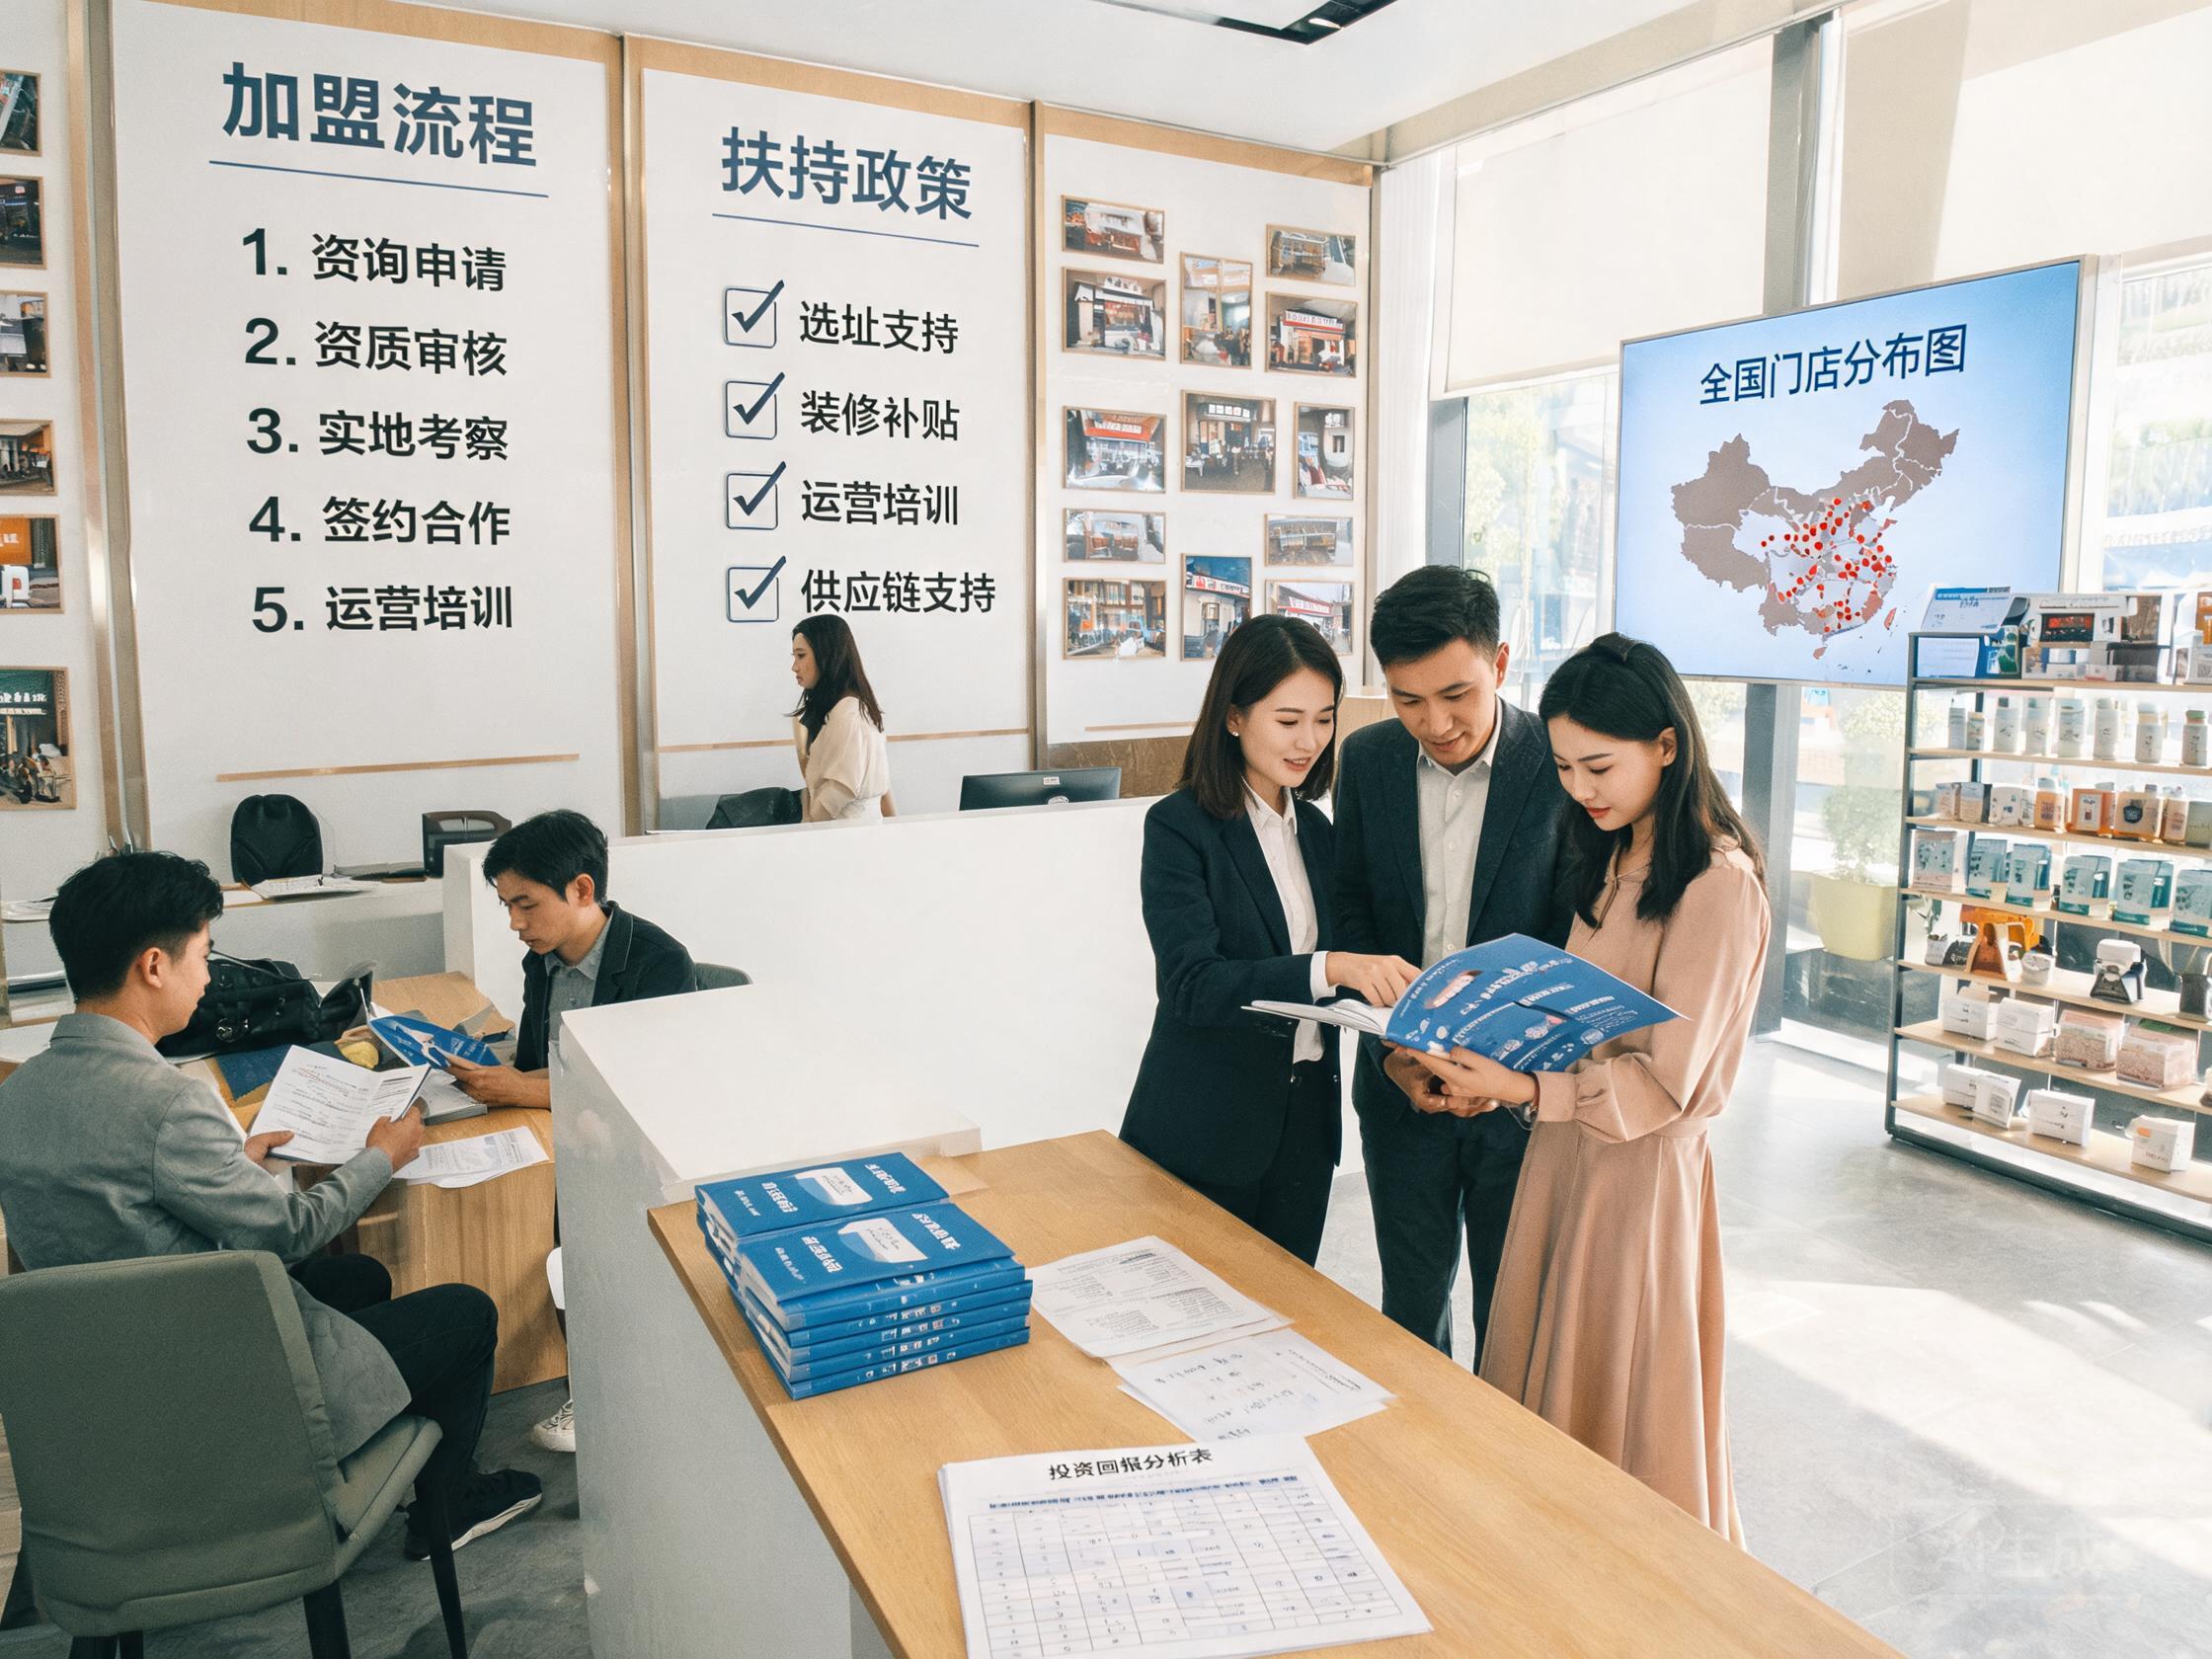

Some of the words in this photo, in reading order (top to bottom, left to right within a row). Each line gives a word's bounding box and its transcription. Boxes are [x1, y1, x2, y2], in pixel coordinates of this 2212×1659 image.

[222, 62, 537, 167] 加盟流程
[721, 126, 973, 220] 扶持政策
[243, 228, 288, 276] 1.
[312, 233, 507, 292] 资询申请
[245, 318, 296, 366] 2.
[314, 321, 508, 377] 资质审核
[799, 301, 959, 355] 选址支持
[1698, 324, 1968, 405] 全国门店分布图
[247, 408, 299, 455] 3.
[319, 410, 509, 461] 实地考察
[800, 390, 960, 441] 装修补贴
[249, 497, 301, 543] 4.
[322, 496, 511, 546] 签约合作
[801, 480, 958, 526] 运营培训
[253, 587, 304, 633] 5.
[326, 585, 513, 632] 运营培训
[800, 569, 996, 614] 供应链支持
[1049, 1448, 1213, 1480] 投资回报分析表
